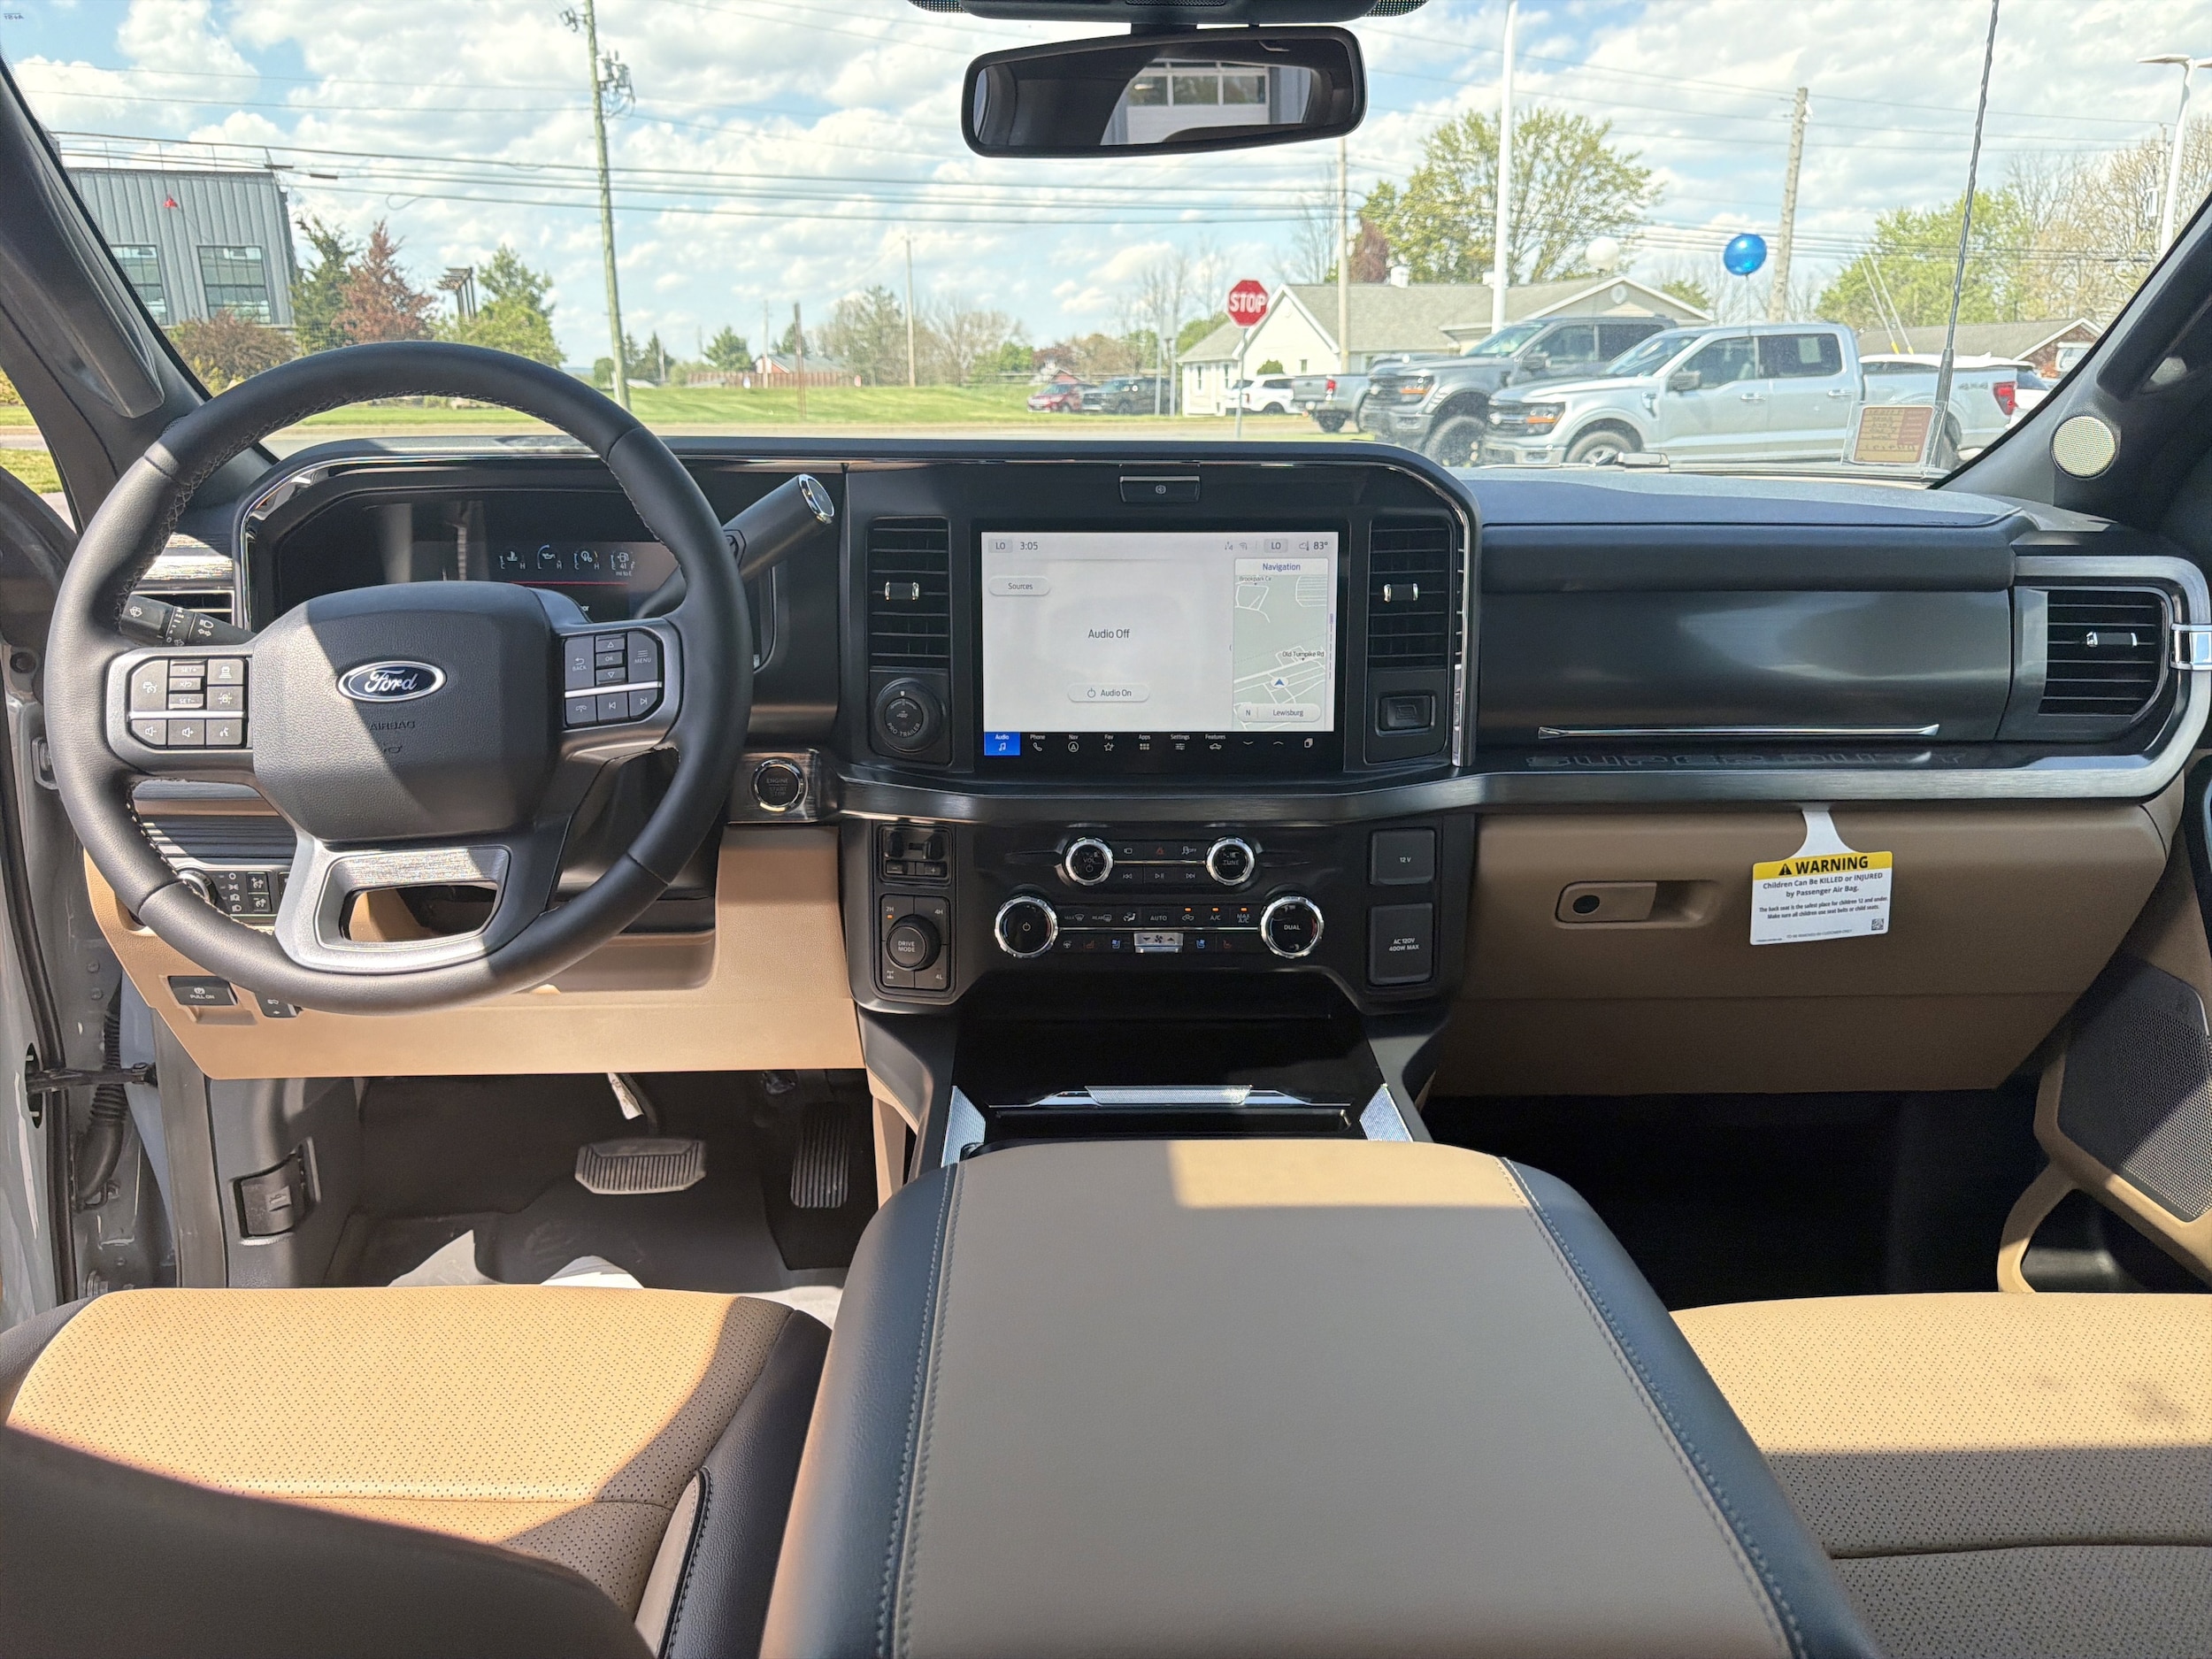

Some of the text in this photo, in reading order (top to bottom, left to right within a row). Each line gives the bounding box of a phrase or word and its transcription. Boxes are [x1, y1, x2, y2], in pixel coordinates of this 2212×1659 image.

[1230, 293, 1266, 313] STOP
[995, 541, 1006, 550] LO
[1019, 541, 1039, 550] 3:05
[1271, 541, 1281, 550] LO
[1313, 541, 1328, 550] 83°
[1262, 563, 1301, 572] Navigation
[1087, 629, 1130, 639] Audio Off
[364, 669, 419, 693] Ford
[1101, 688, 1132, 697] Audio On
[887, 722, 921, 737] PRO TRAILER
[1795, 856, 1869, 875] WARNING
[1854, 872, 1883, 881] INJURED
